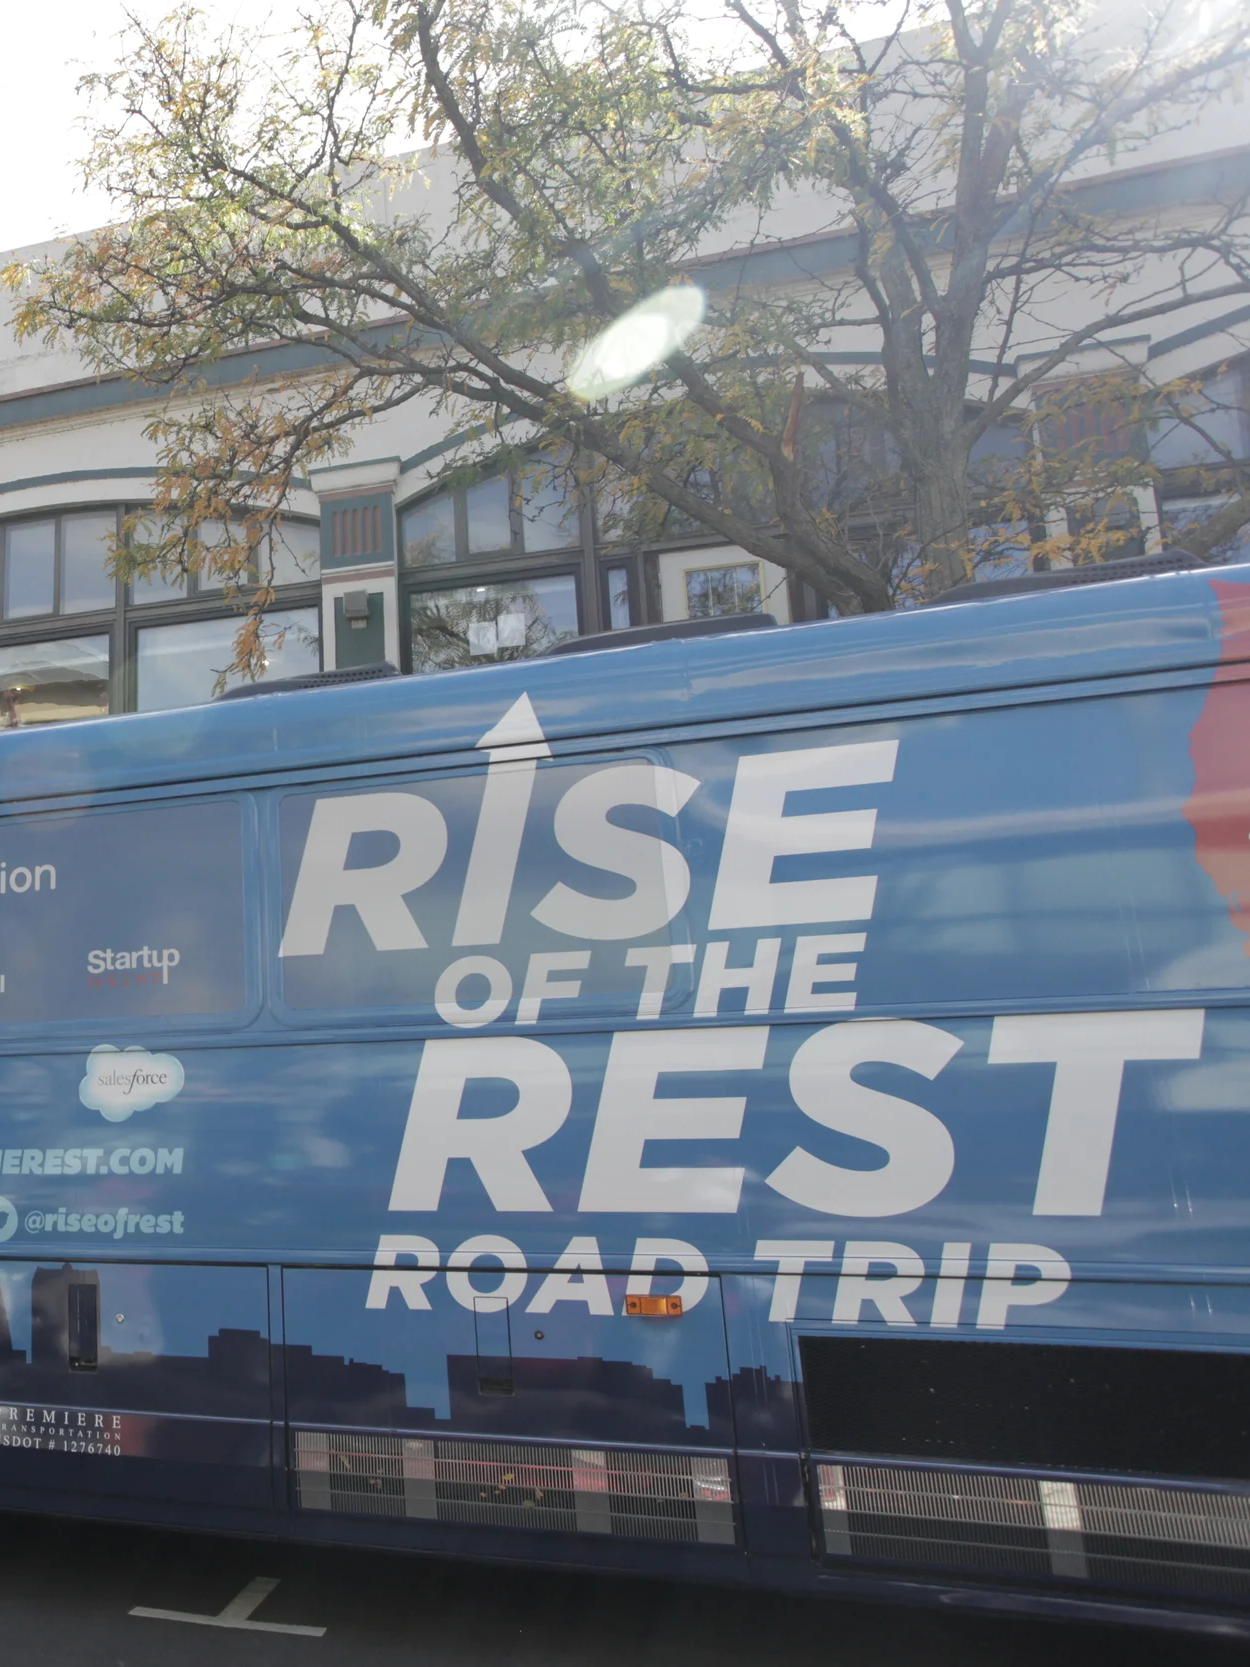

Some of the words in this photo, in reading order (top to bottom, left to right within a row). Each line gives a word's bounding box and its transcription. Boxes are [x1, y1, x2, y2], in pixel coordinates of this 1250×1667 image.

[277, 690, 899, 957] RISE
[87, 946, 180, 984] Startup
[433, 950, 592, 1028] OF
[623, 933, 867, 1020] THE
[97, 1067, 168, 1095] salesforce
[388, 1008, 1205, 1217] REST
[24, 1207, 185, 1240] @riseofrest
[365, 1234, 709, 1316] ROAD
[752, 1240, 1071, 1329] TRIP
[48, 1440, 56, 1451] #
[63, 1441, 121, 1456] 1276740
